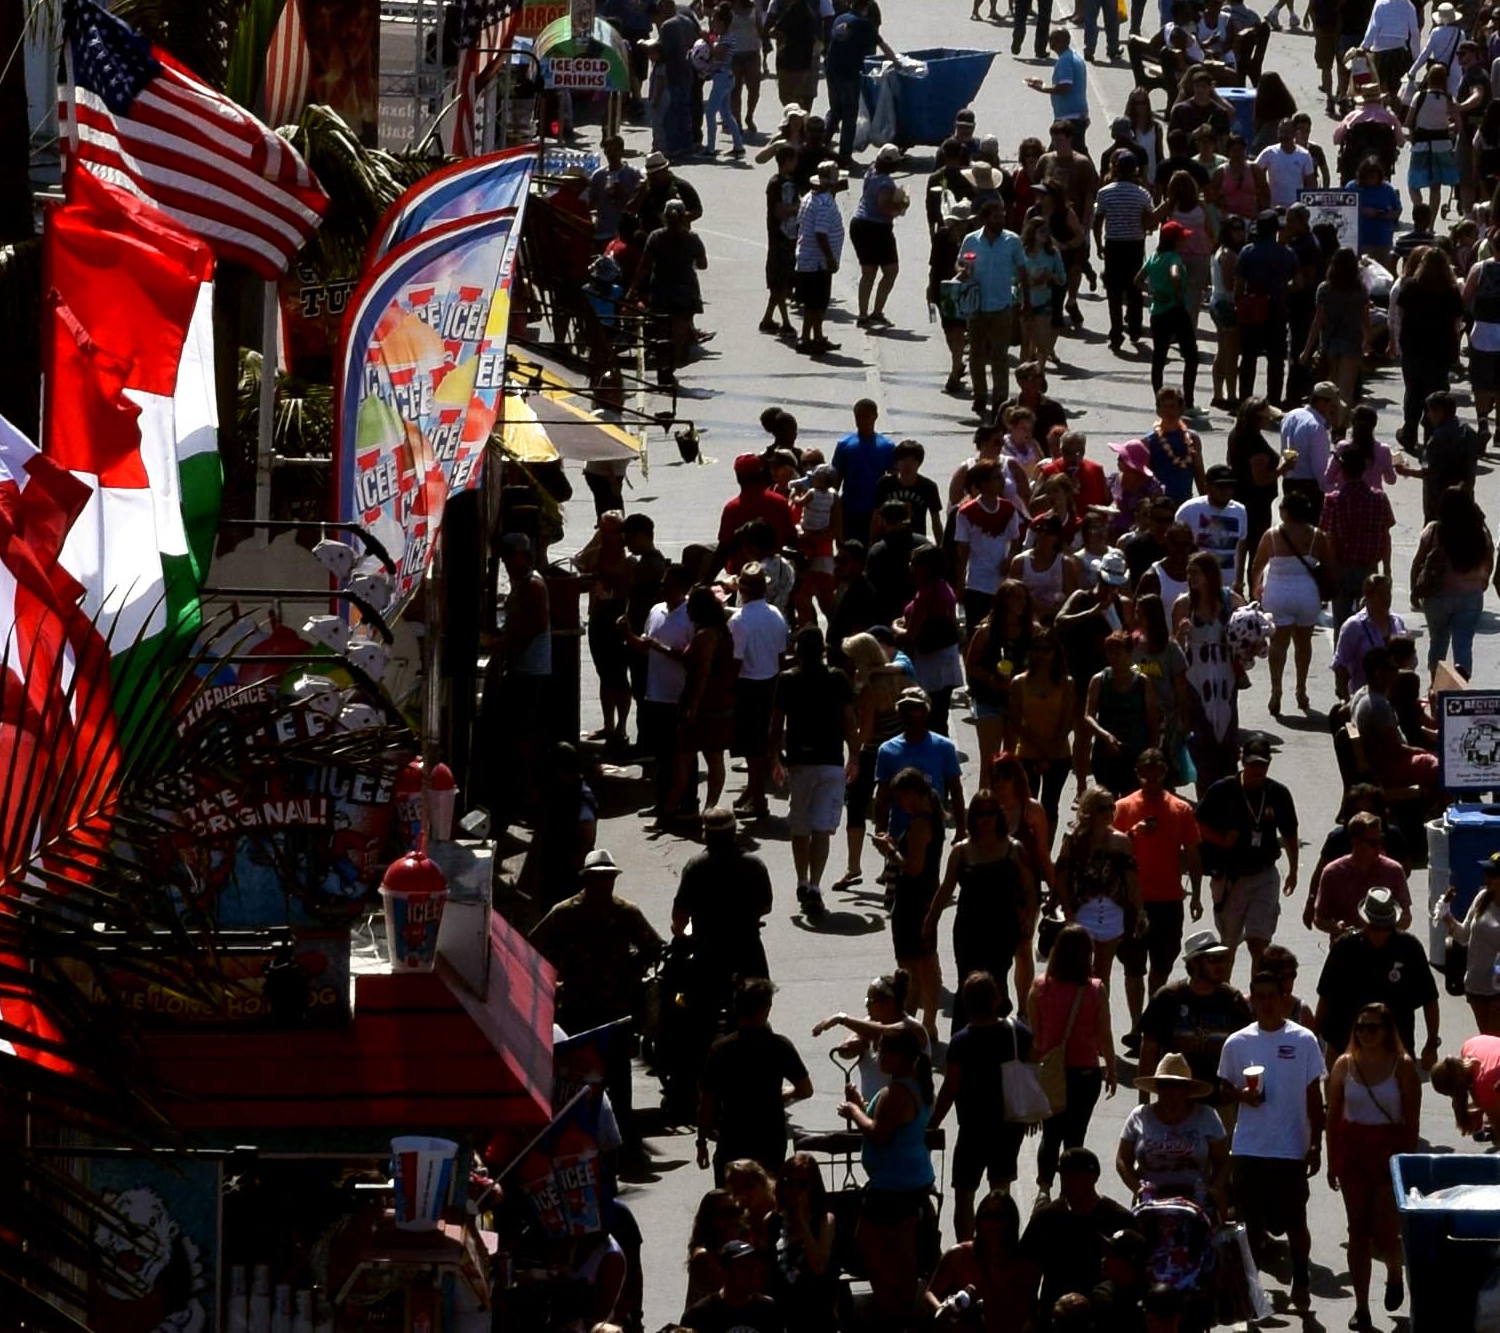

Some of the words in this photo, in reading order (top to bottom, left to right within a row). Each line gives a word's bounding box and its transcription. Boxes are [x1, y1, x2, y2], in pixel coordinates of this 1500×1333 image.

[550, 58, 571, 73] ICE
[573, 58, 608, 73] COLD
[444, 302, 487, 343] ICEE
[354, 452, 399, 510] ICEE
[405, 900, 442, 926] ICEE
